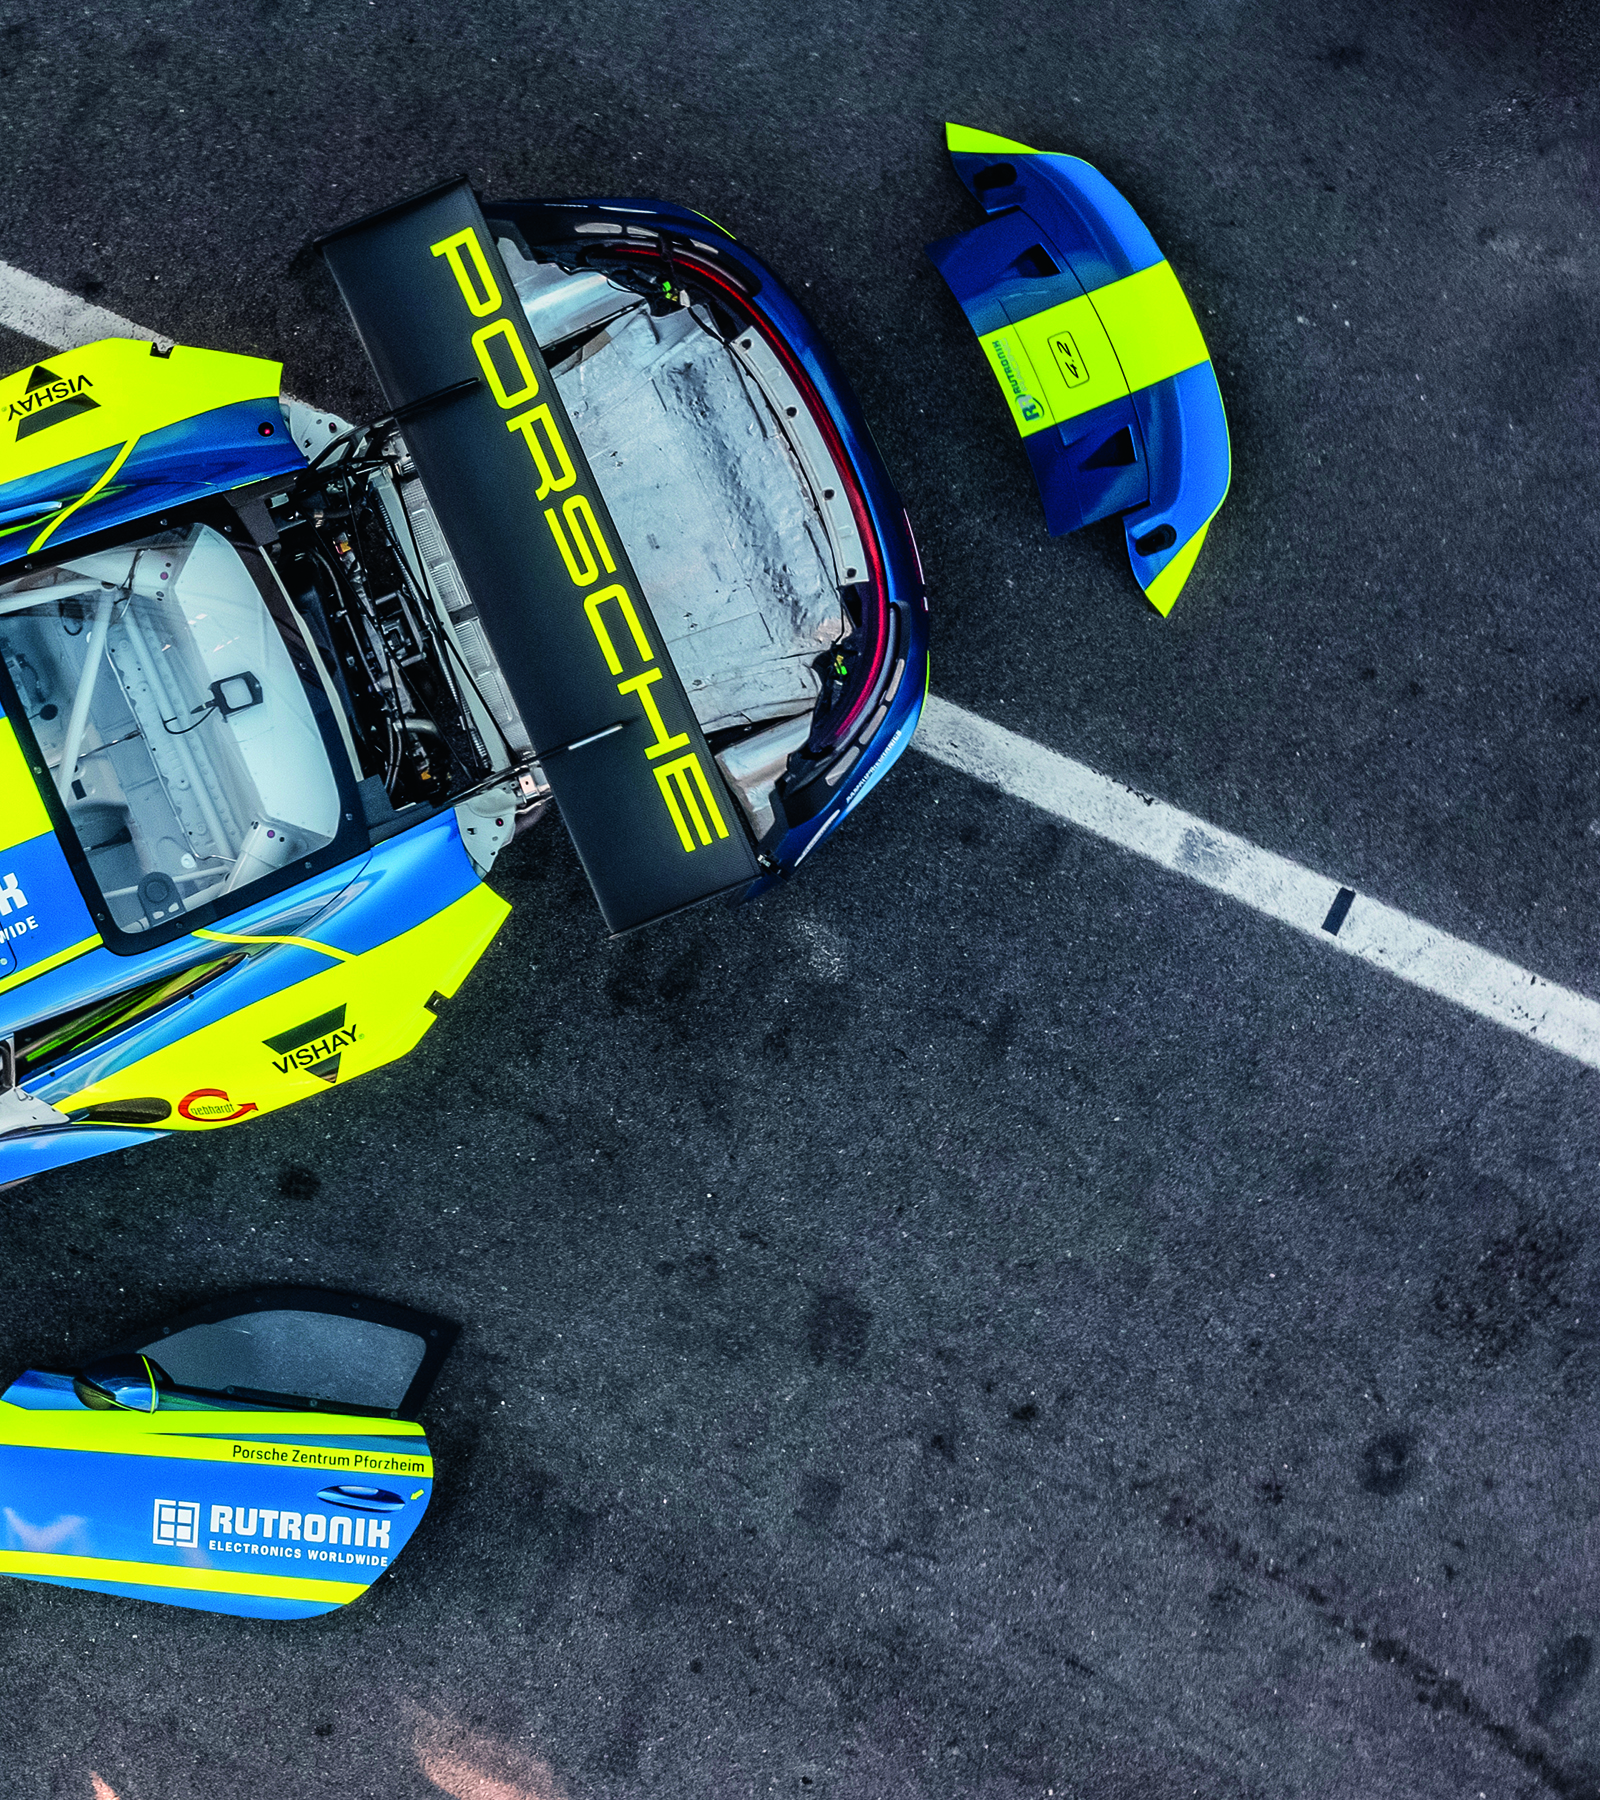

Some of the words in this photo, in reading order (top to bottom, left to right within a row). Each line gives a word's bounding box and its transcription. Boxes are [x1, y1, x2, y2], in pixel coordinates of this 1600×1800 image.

[992, 340, 1021, 394] RUTRONIK
[8, 374, 94, 422] VISHAY
[429, 226, 731, 853] PORSCHE
[271, 1024, 357, 1074] VISHAY
[232, 1444, 288, 1462] Porsche
[291, 1449, 350, 1467] Zentrum
[354, 1454, 425, 1473] Pforzheim
[209, 1504, 391, 1549] RUTRONIK
[208, 1540, 302, 1559] ELECTRONICS
[307, 1549, 388, 1567] WORLDWIDE
